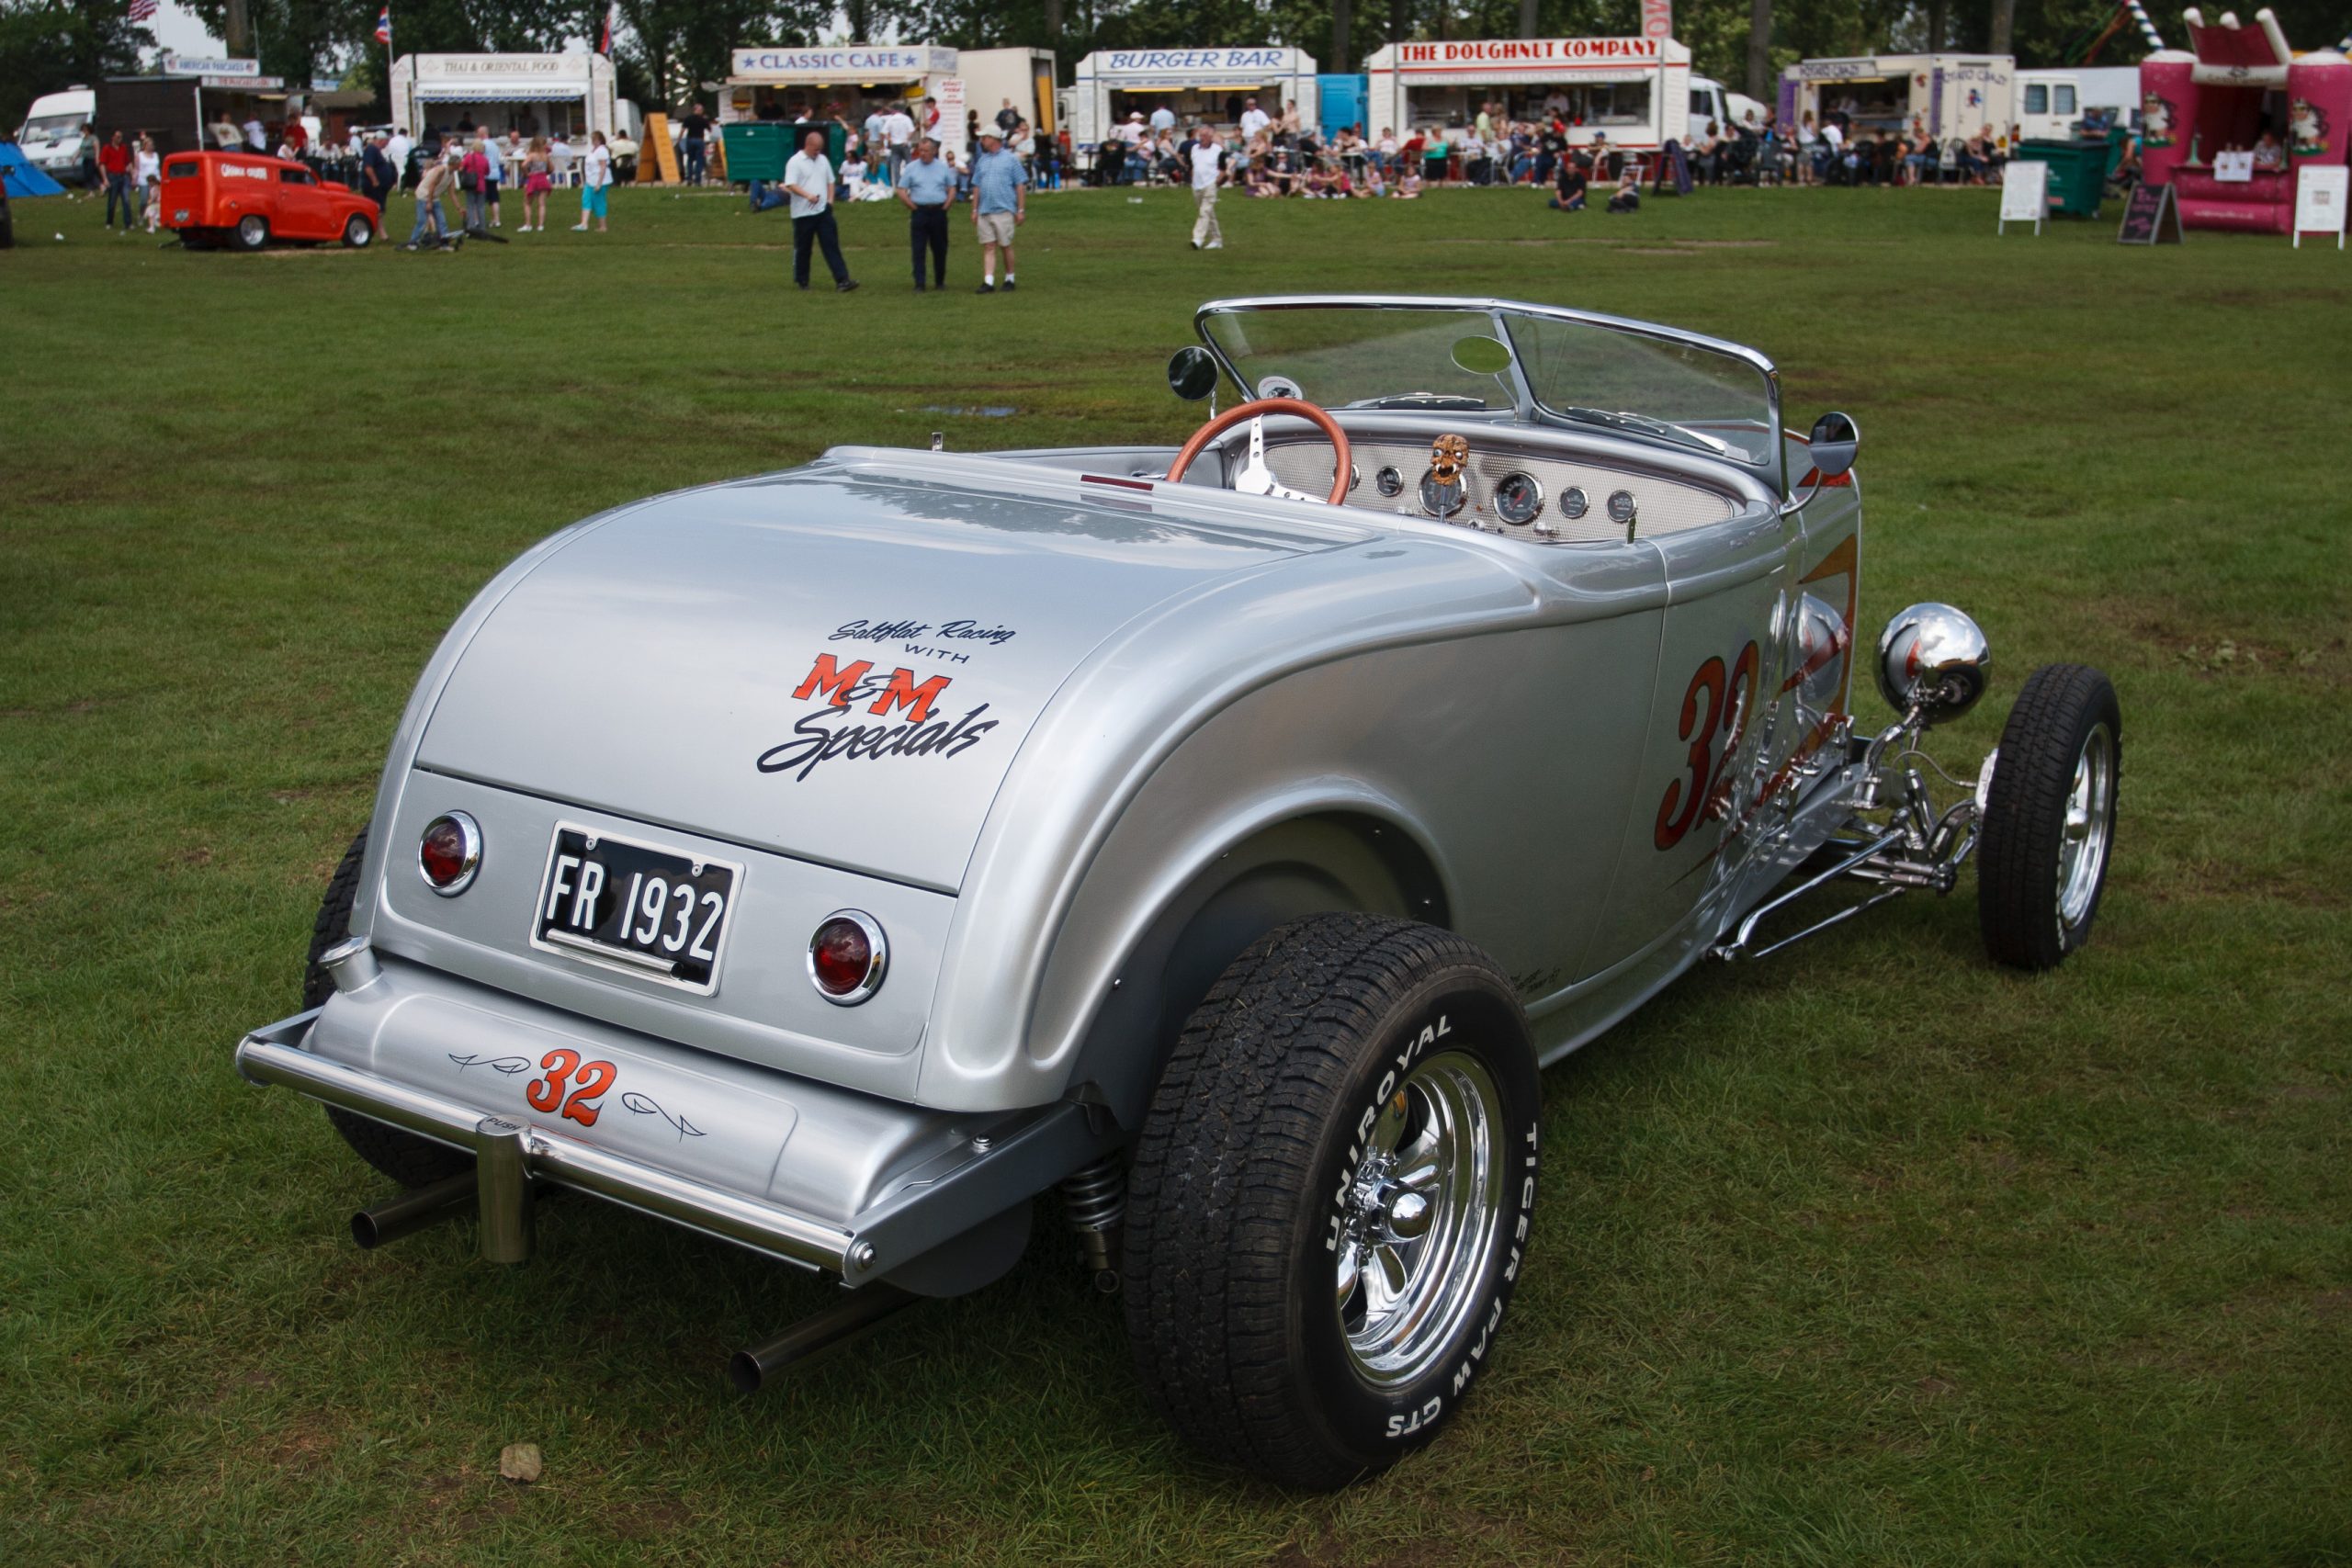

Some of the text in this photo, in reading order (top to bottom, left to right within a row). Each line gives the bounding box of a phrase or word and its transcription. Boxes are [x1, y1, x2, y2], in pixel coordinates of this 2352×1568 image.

[445, 61, 559, 73] THAI & ORIENTAL FOOD
[760, 52, 899, 69] CLASSIC CAFE
[1110, 51, 1283, 69] BURGER BAR
[1402, 39, 1657, 61] THE DOUGHNUT COMPANY
[828, 620, 1016, 645] Saltflat Racing
[904, 643, 970, 664] WITH
[791, 652, 953, 723] M&M
[756, 703, 999, 782] Specials
[547, 855, 724, 962] FR 1932
[526, 1048, 617, 1127] 32
[486, 1117, 522, 1131] PUSH
[1327, 1015, 1452, 1251] UNIROYAL
[1504, 1122, 1536, 1281] TIGER
[1453, 1297, 1502, 1396] PAW
